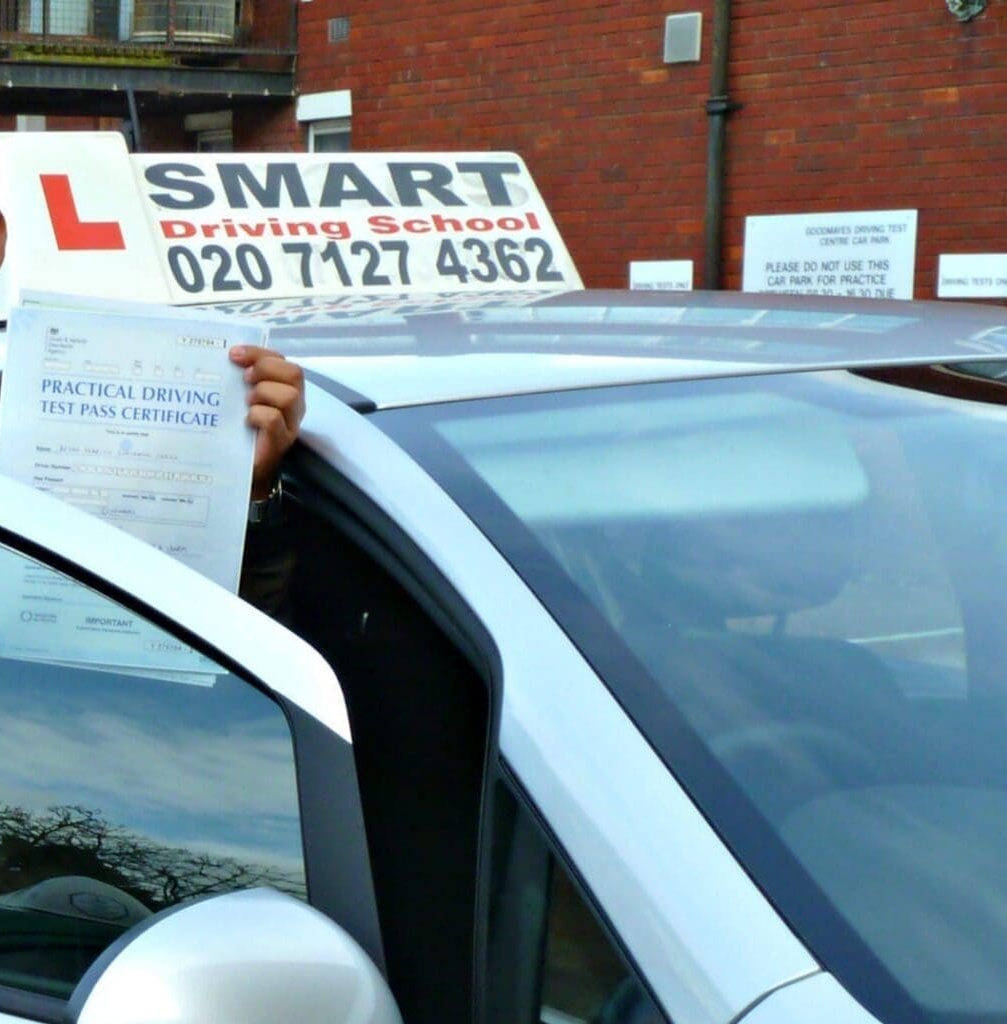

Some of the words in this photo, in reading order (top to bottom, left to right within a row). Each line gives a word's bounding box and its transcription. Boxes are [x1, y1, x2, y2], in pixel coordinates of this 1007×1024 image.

[144, 162, 520, 210] SMART
[39, 174, 126, 250] L
[160, 220, 351, 240] Driving
[369, 213, 540, 235] School
[852, 236, 868, 245] CAR
[870, 235, 890, 244] PARK
[888, 223, 907, 232] TEST
[167, 244, 272, 293] 020
[282, 240, 410, 288] 7127
[436, 237, 564, 283] 4362
[765, 261, 800, 272] PLEASE
[803, 260, 818, 271] DO
[821, 260, 840, 271] NOT
[844, 259, 864, 271] USE
[867, 259, 890, 270] THIS
[767, 275, 786, 286] CAR
[789, 275, 813, 286] PARK
[817, 274, 837, 285] FOR
[840, 273, 888, 285] PRACTICE
[41, 378, 136, 400] PRACTICAL
[142, 386, 221, 407] DRIVING
[40, 400, 76, 415] TEST
[80, 403, 117, 419] PASS
[121, 406, 220, 428] CERTIFICATE
[85, 616, 133, 628] IMPORTANT
